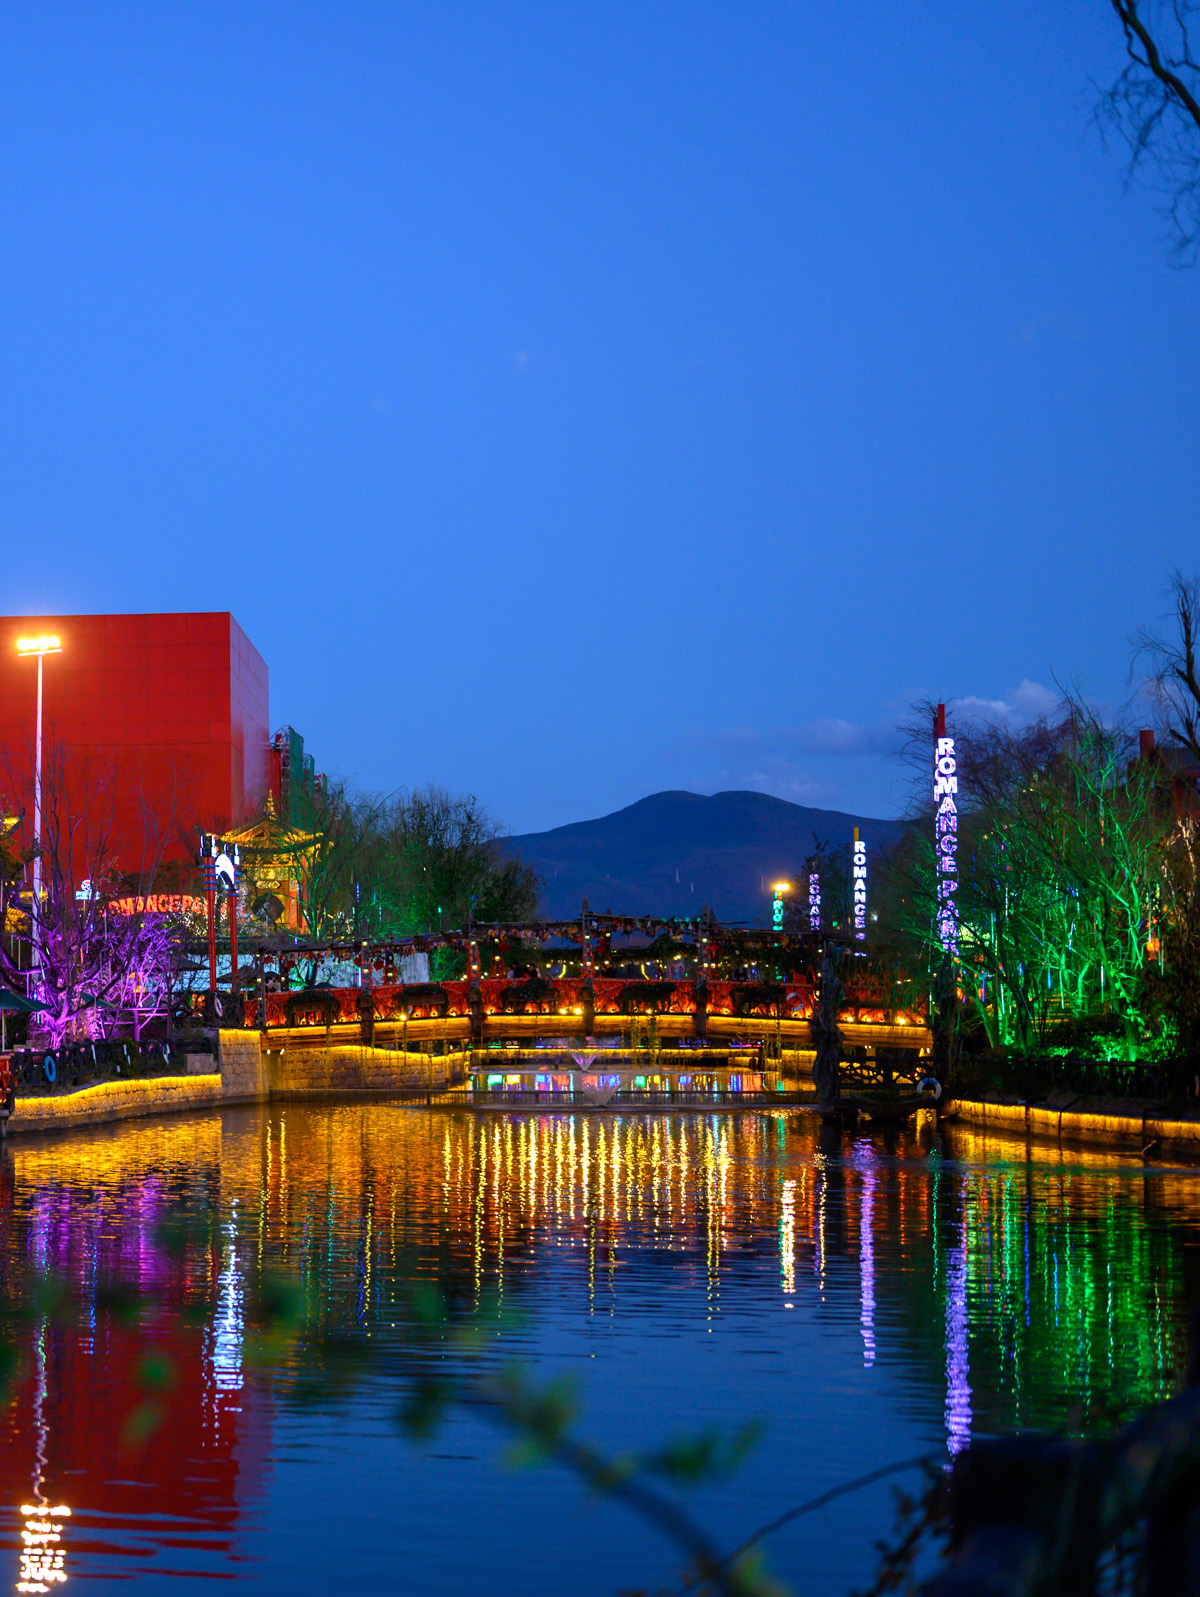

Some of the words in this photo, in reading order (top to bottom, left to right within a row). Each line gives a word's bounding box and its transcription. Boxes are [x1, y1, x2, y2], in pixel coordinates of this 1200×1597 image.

[937, 737, 958, 873] ROMANCE
[97, 893, 179, 920] OMANCE
[853, 841, 867, 929] ROMANCE
